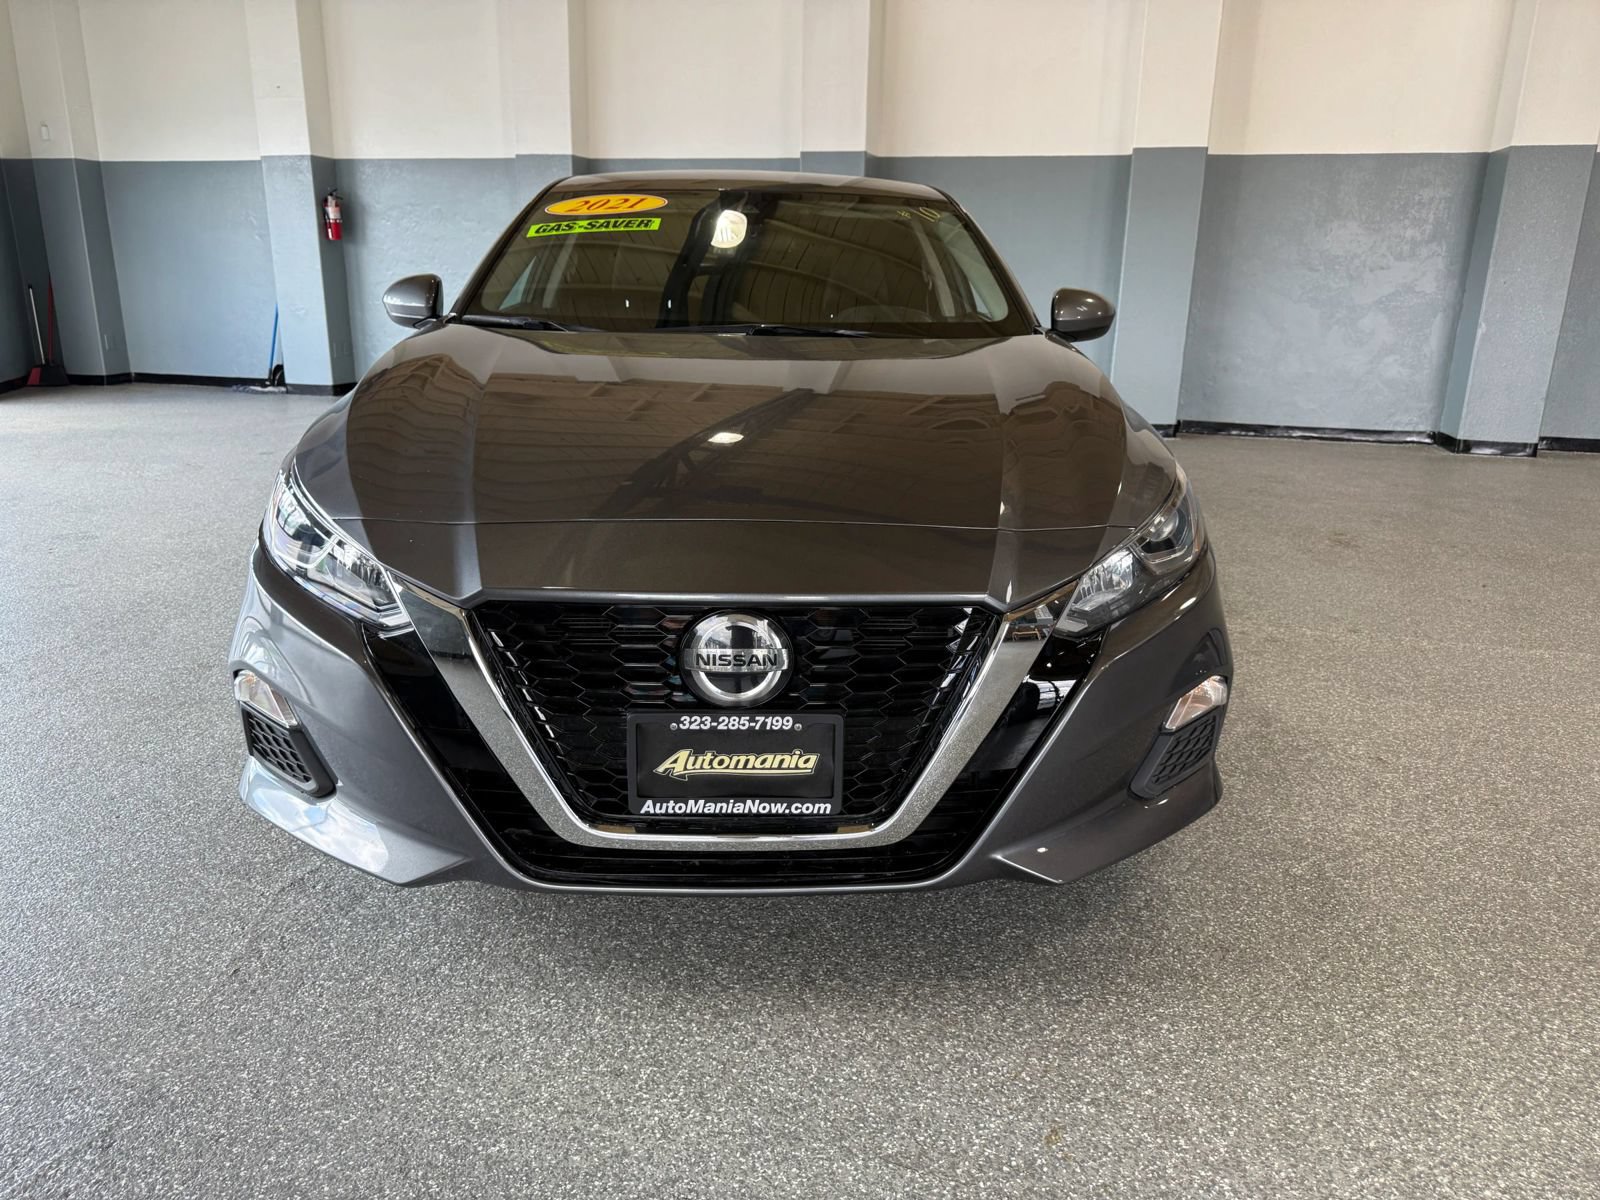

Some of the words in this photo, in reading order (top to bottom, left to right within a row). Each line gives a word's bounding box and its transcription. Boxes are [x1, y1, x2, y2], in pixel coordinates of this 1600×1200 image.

[564, 197, 648, 212] 2021
[534, 219, 653, 233] GAS-SAVER
[695, 653, 778, 667] NISSAN
[679, 716, 793, 730] 323-285-7199
[654, 749, 819, 779] Automania
[640, 800, 832, 815] AutoManiaNow.com
